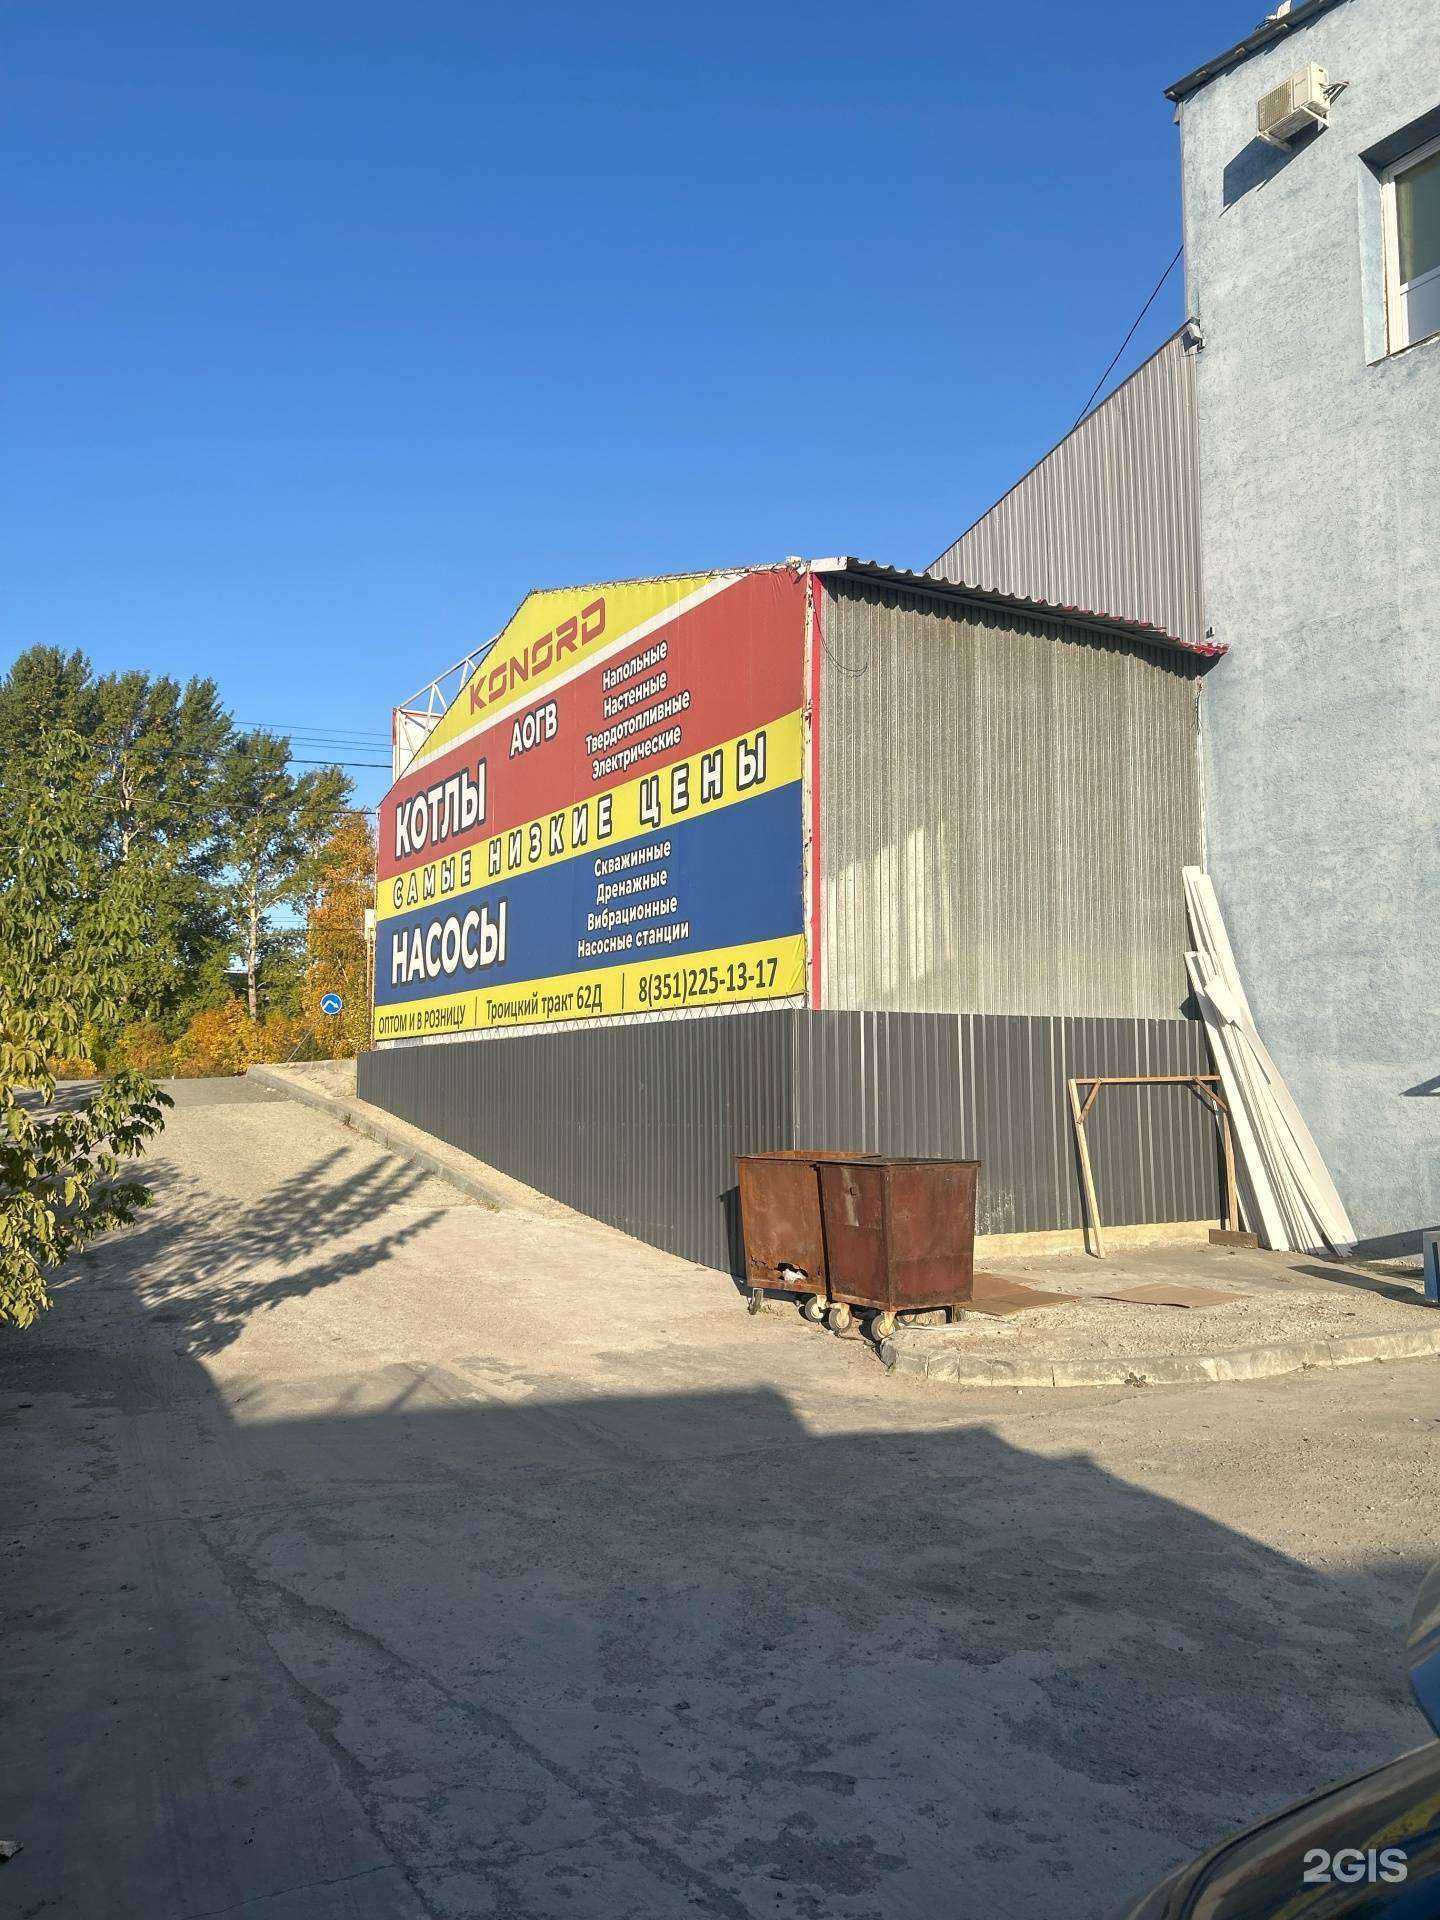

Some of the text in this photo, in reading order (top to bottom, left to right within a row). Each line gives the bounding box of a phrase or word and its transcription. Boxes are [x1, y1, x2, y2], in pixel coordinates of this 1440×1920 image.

[470, 597, 605, 715] KONORD
[602, 640, 668, 691] Напольные
[604, 671, 667, 719] Настенные
[509, 699, 558, 759] АОГВ
[585, 690, 690, 755] Твердотопливные
[592, 726, 682, 780] Электрические
[393, 731, 766, 909] САМЫЕ НИЗКИЕ ЦЕНЫ
[395, 758, 487, 858] КОТЛЫ
[594, 840, 671, 877] Скважинные
[596, 870, 667, 904] Дренажные
[587, 896, 677, 931] Вибрационные
[391, 899, 508, 986] НАСОСЫ
[577, 921, 689, 958] Насосные станции
[486, 984, 603, 1021] Троицкий тракт 62Д
[638, 958, 778, 1007] 8(351)225-13-17
[378, 1005, 466, 1034] ОПТОМ И В РОЗНИЦУ
